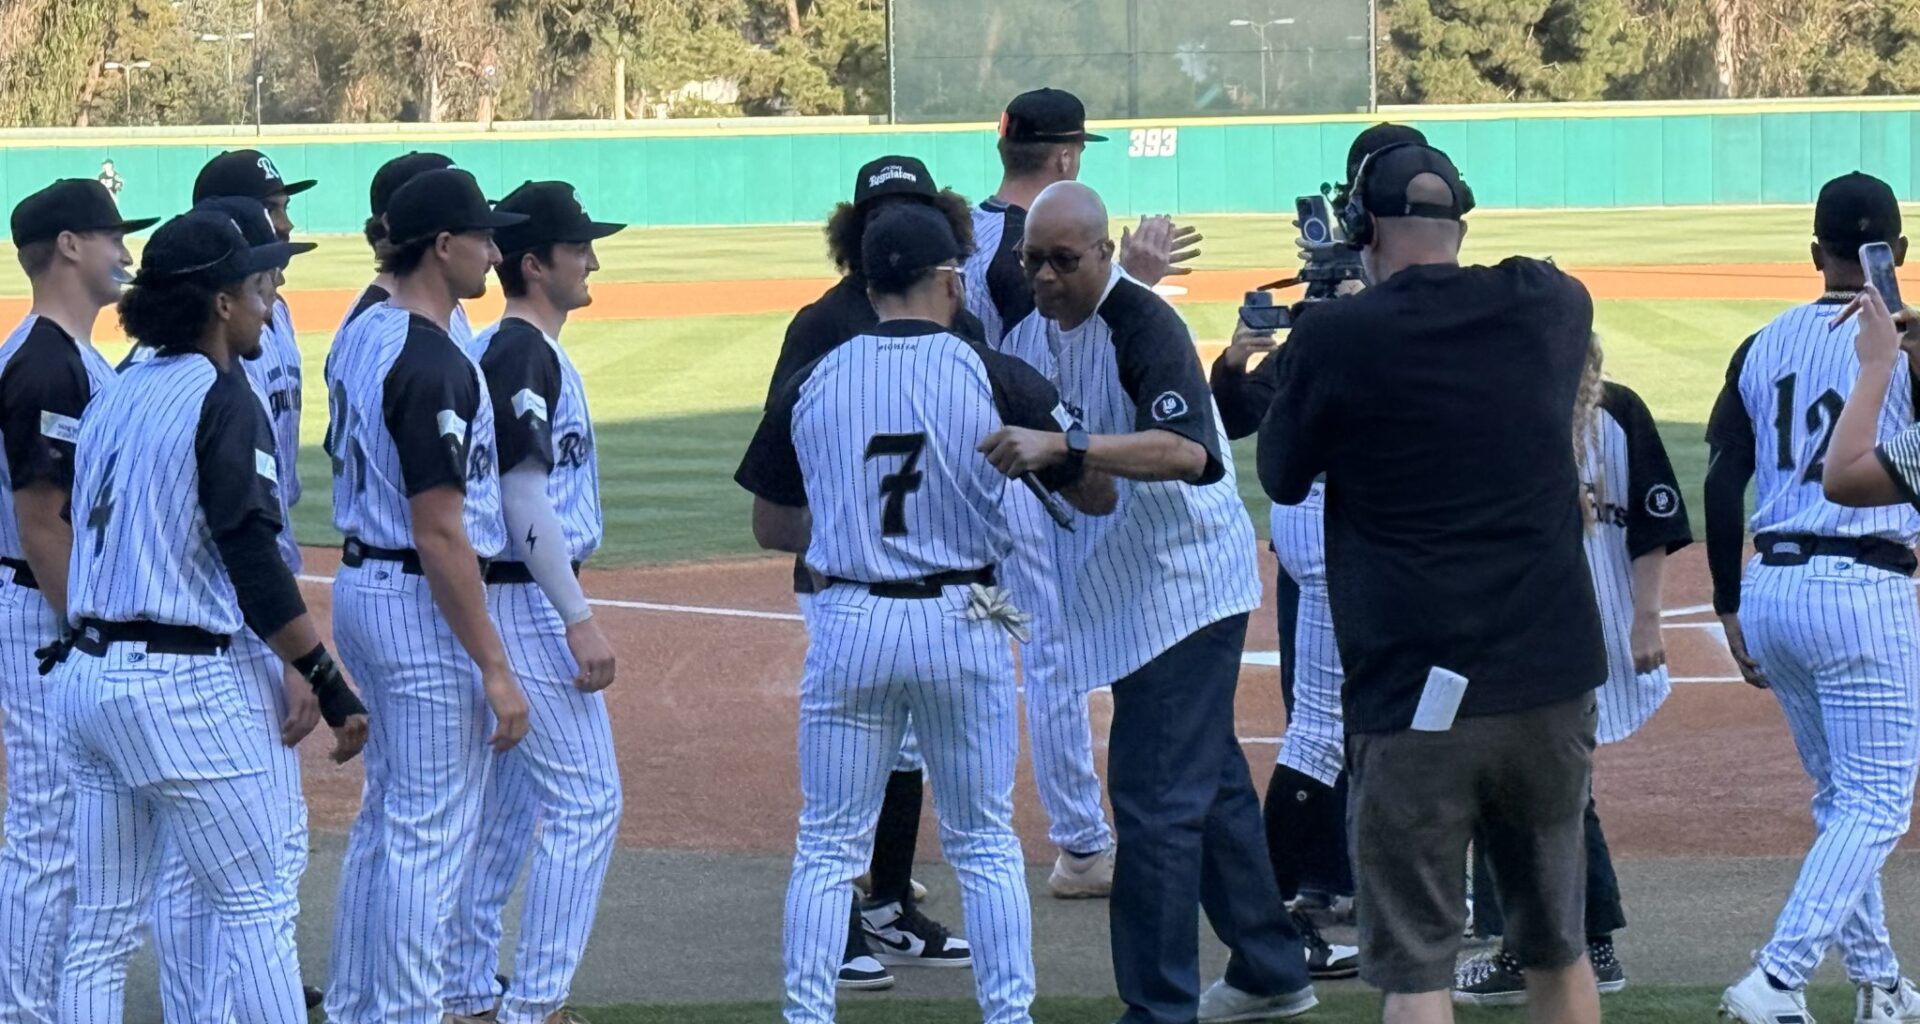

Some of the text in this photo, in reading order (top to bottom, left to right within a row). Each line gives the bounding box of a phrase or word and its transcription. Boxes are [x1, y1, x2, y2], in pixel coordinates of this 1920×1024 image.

[1128, 128, 1177, 157] 393
[257, 156, 280, 179] R
[869, 166, 917, 188] Regulators
[1774, 372, 1845, 486] 12
[864, 431, 927, 538] 7
